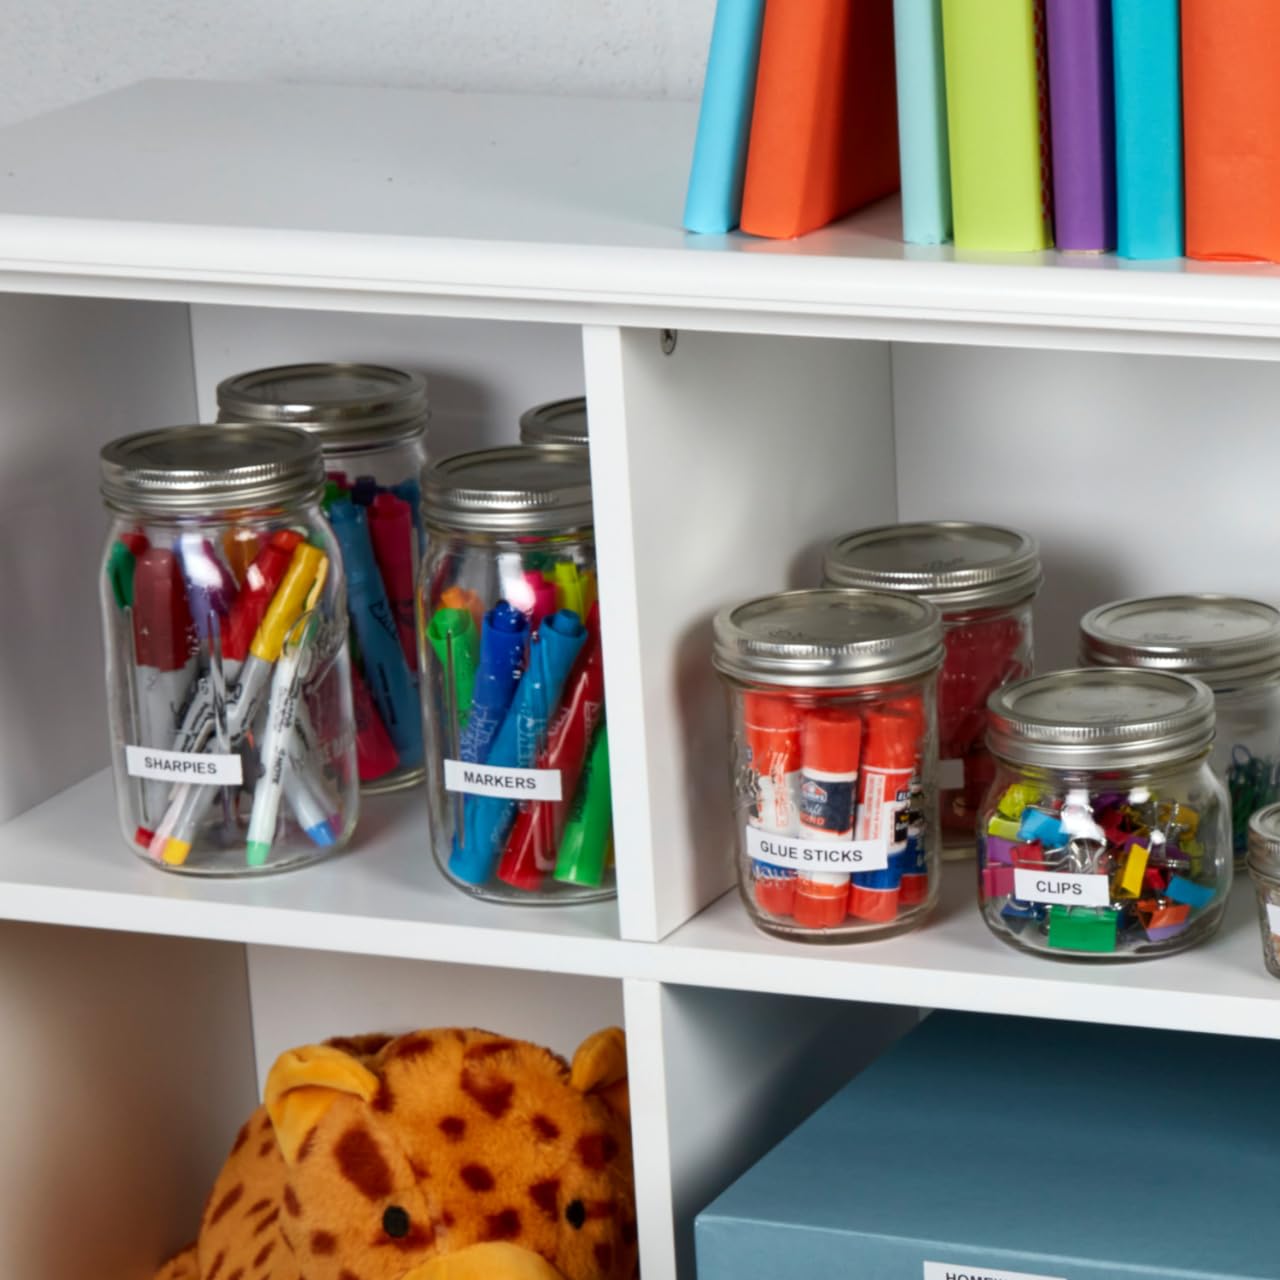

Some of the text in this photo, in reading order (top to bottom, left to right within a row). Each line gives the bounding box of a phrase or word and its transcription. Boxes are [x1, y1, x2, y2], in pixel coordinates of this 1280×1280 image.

[144, 756, 218, 775] SHARPIES
[463, 771, 537, 790] MARKERS
[760, 840, 863, 862] GLUE STICKS
[1036, 880, 1083, 895] CLIPS
